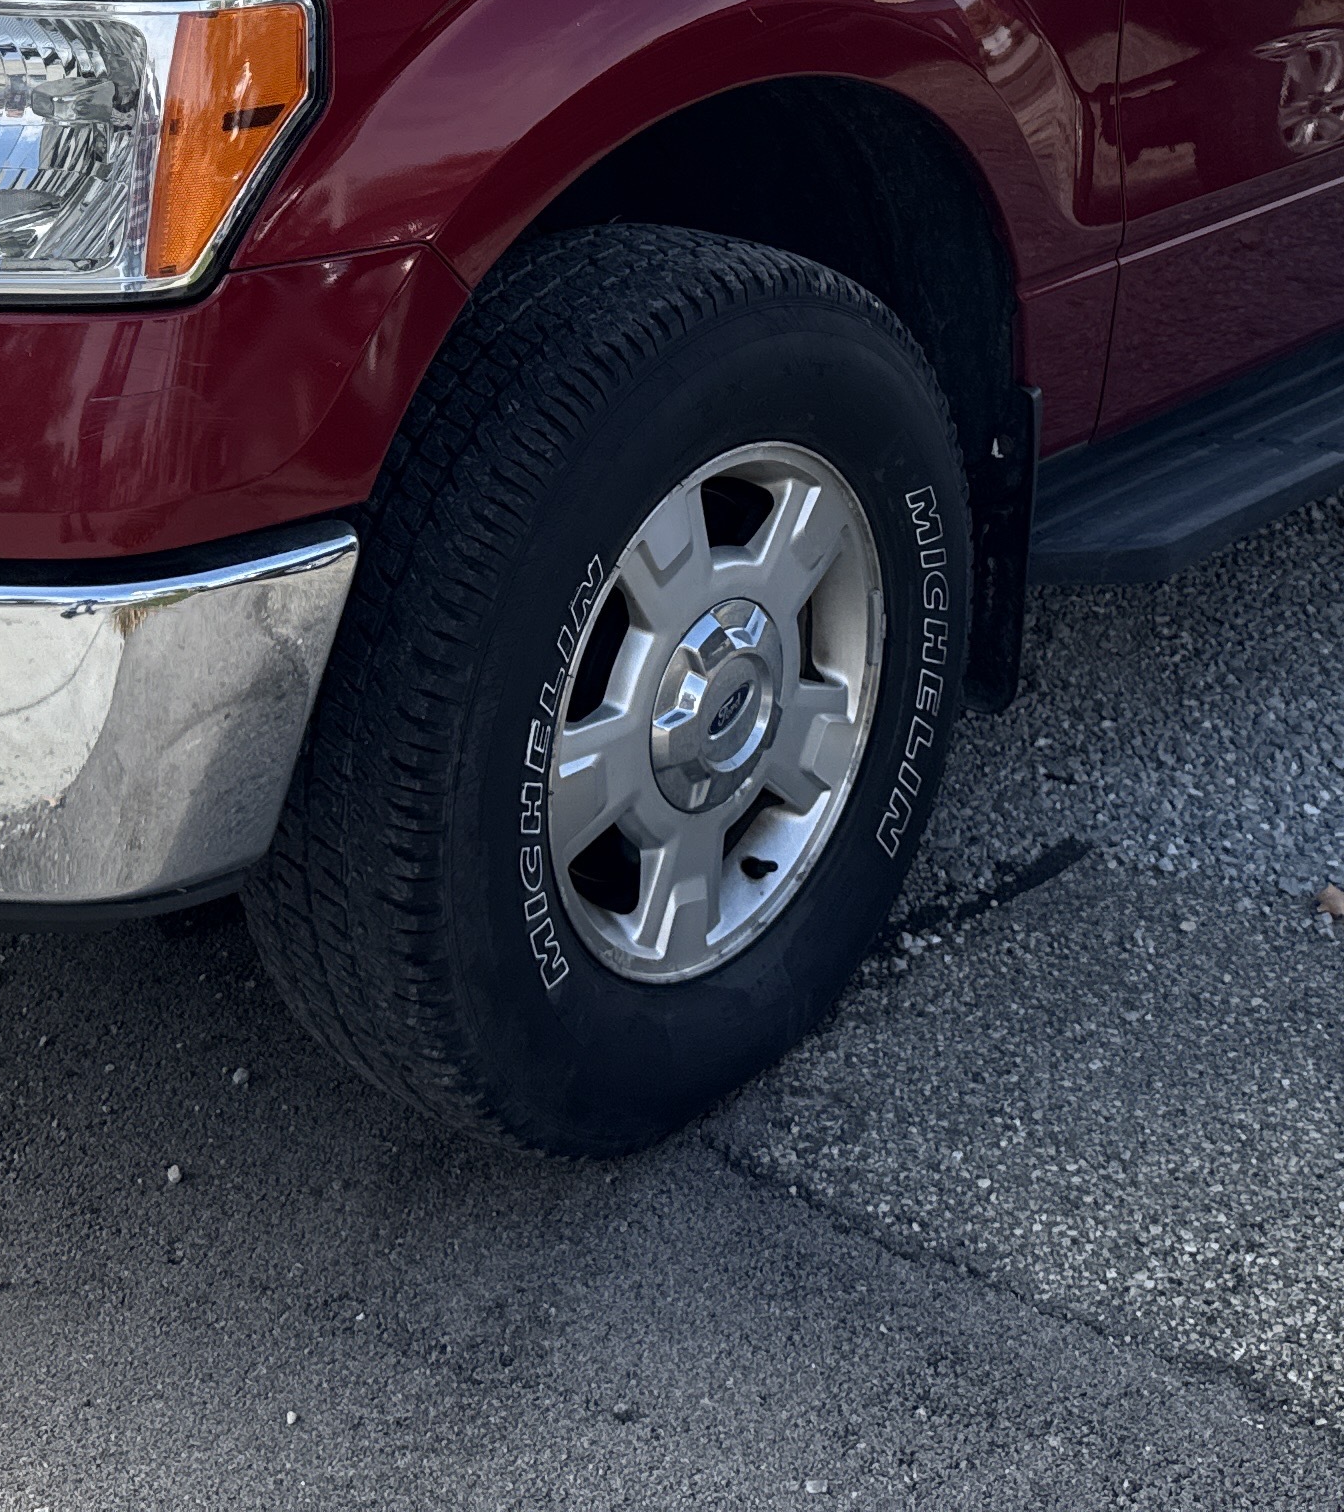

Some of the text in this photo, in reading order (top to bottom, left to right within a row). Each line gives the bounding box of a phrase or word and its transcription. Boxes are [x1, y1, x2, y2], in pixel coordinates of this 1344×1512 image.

[520, 554, 604, 988] MICHELIN
[717, 692, 741, 726] Ford
[877, 486, 948, 858] MICHELIN
